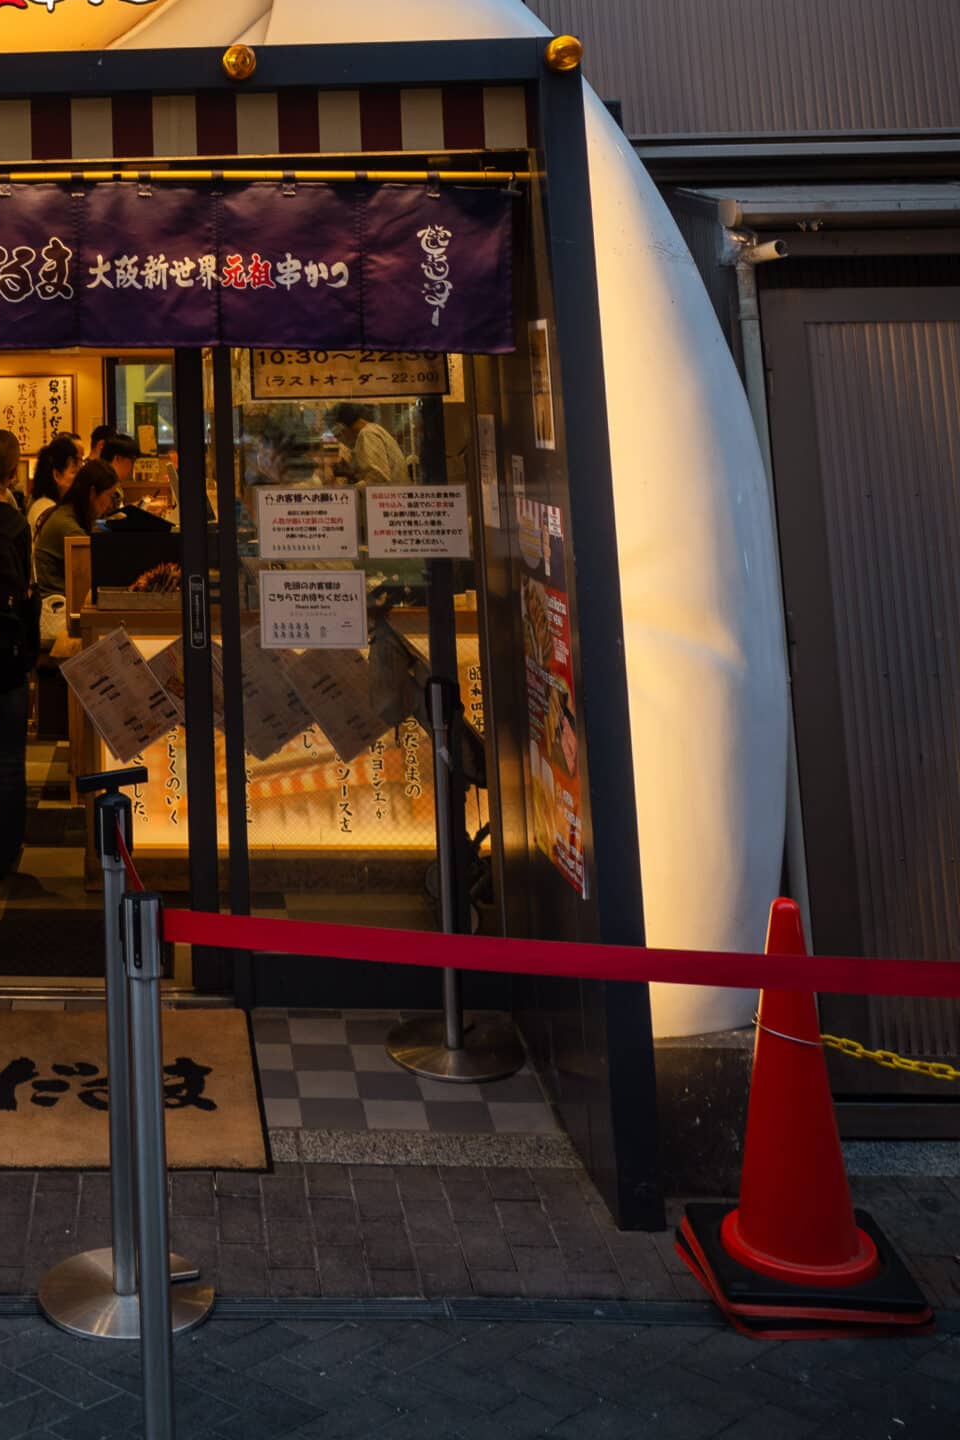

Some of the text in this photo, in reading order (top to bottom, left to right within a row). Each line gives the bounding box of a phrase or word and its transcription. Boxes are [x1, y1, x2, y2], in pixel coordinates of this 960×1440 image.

[86, 252, 350, 291] 大阪新世界元祖串かつ
[166, 727, 181, 825] っとくのいく
